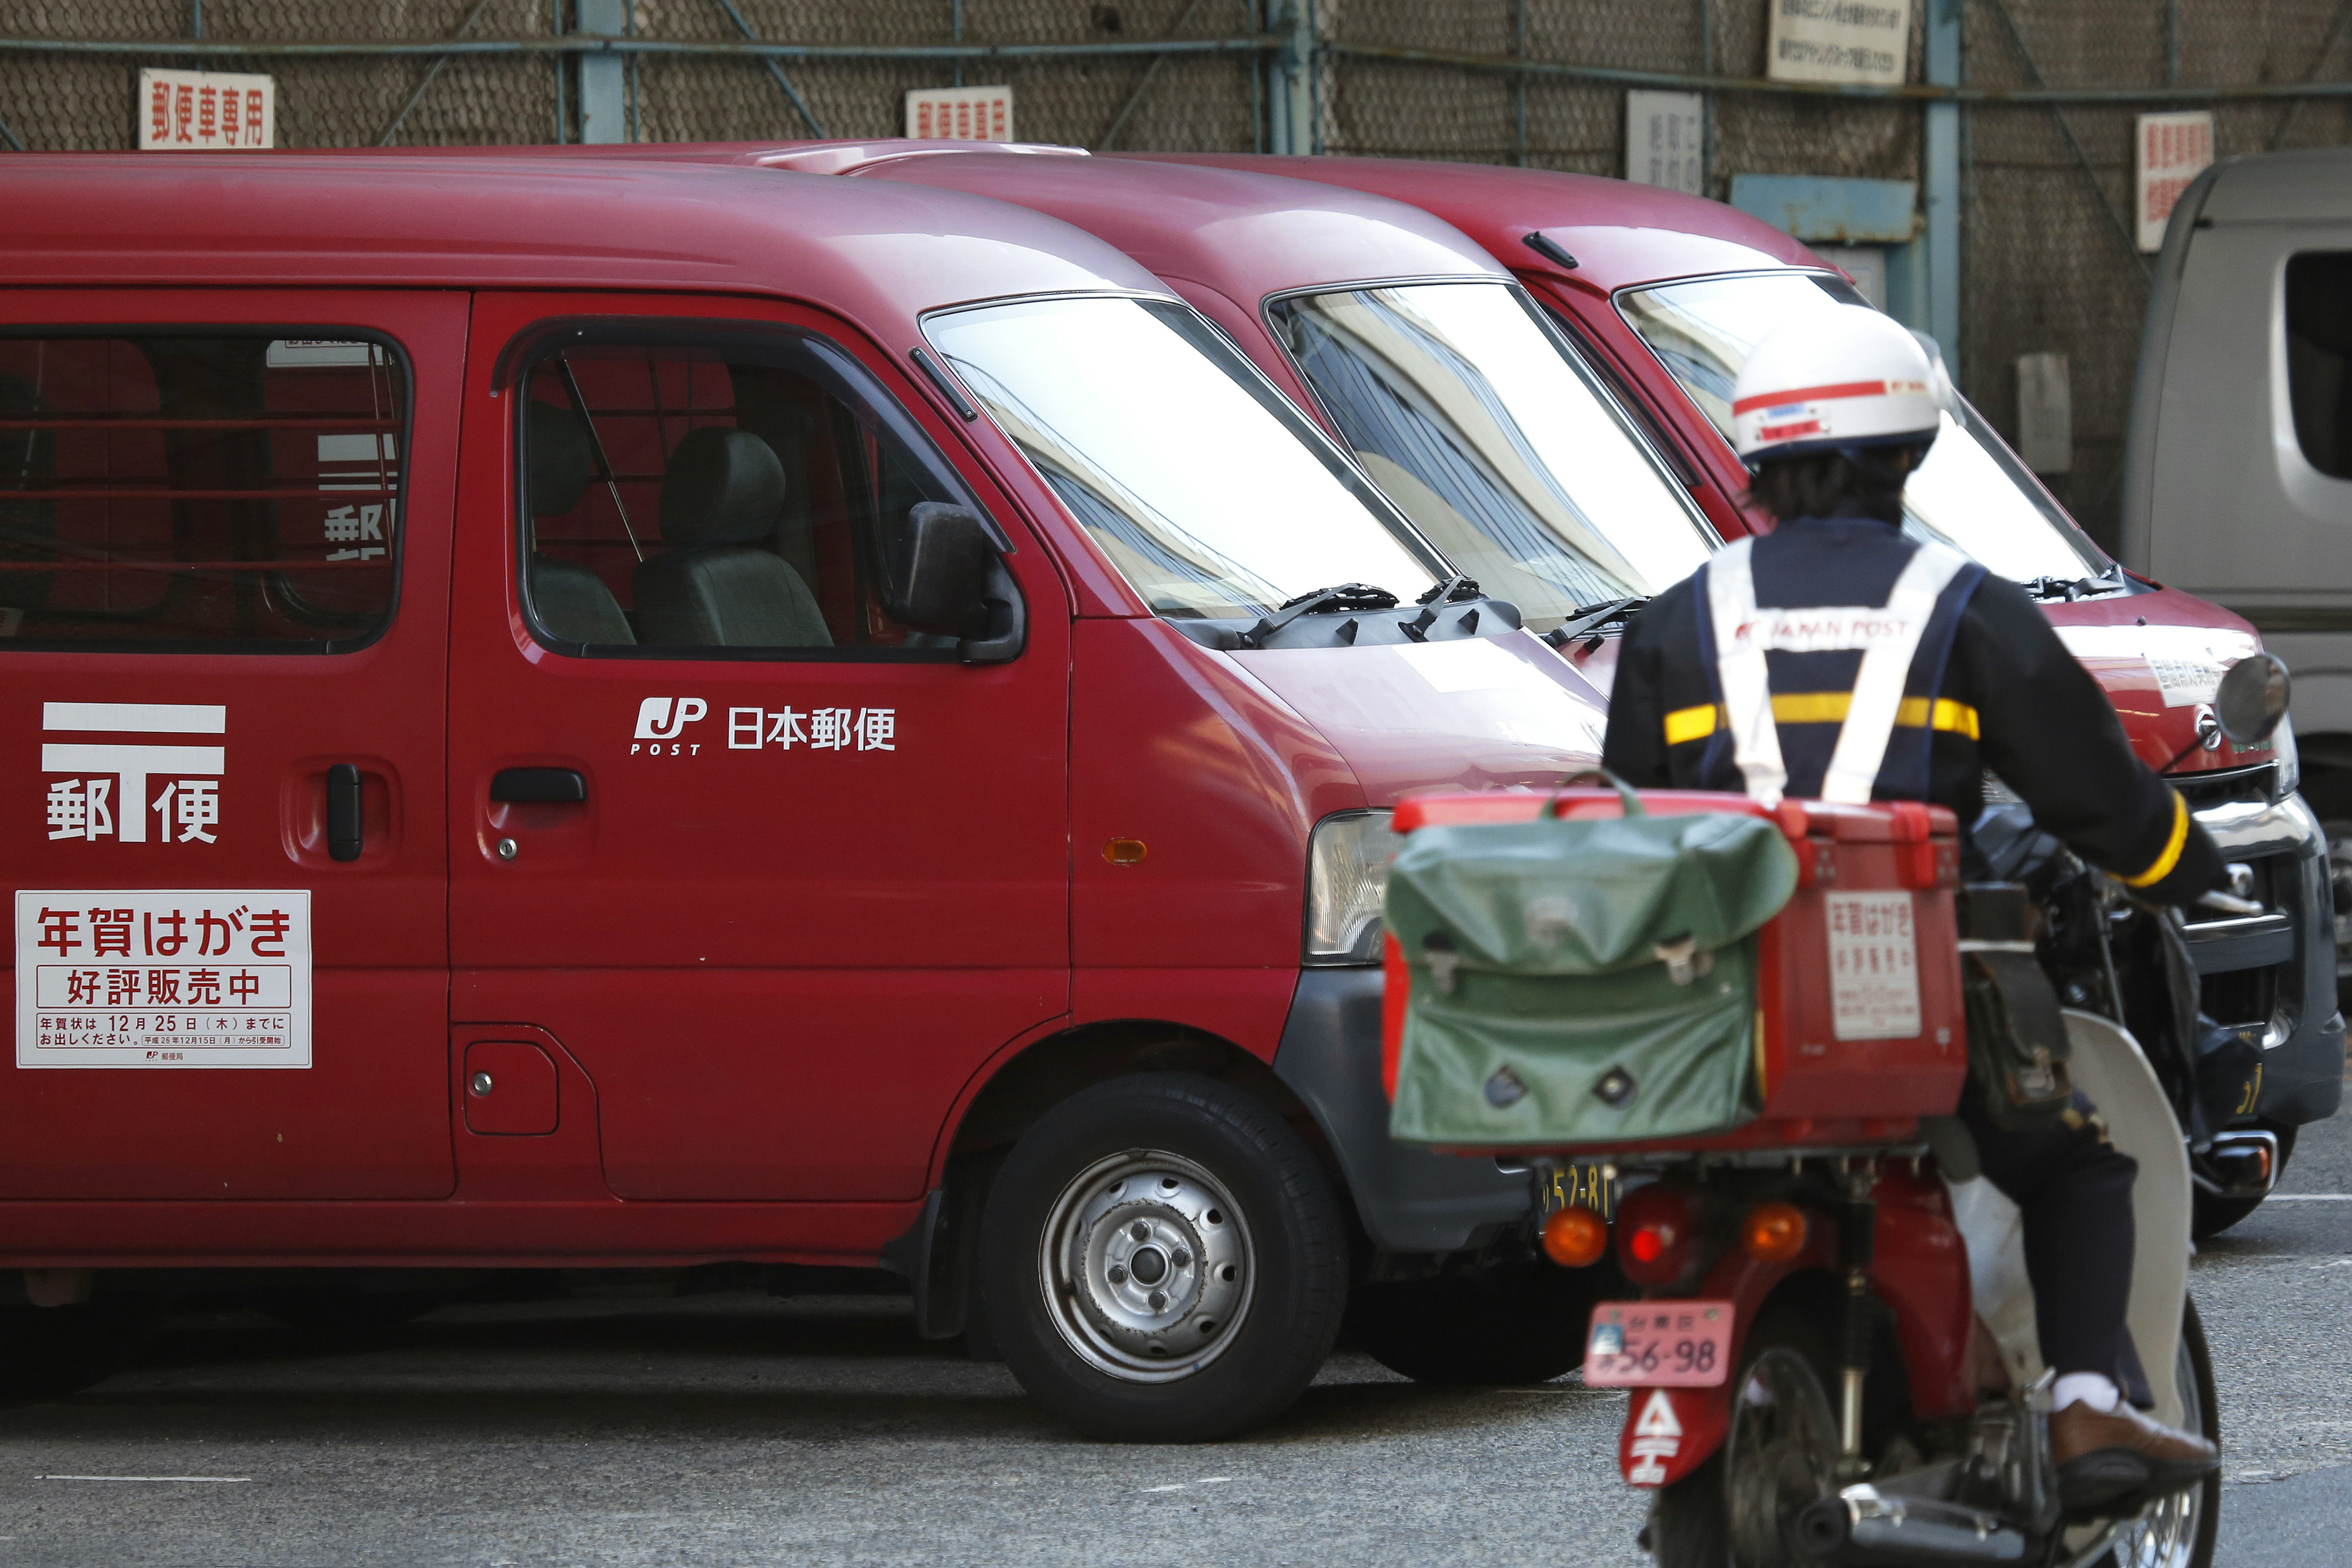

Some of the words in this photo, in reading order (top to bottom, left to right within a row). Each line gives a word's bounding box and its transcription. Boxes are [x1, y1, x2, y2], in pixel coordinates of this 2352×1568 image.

[152, 81, 262, 146] 郵便車専用
[1772, 622, 1840, 637] JAPAN
[1852, 621, 1907, 637] POST
[728, 706, 896, 751] 日本郵便
[630, 743, 701, 756] POST
[37, 904, 290, 958] 年賀はがき
[67, 968, 260, 1005] 好評販売中
[161, 1052, 183, 1061] 郵便局
